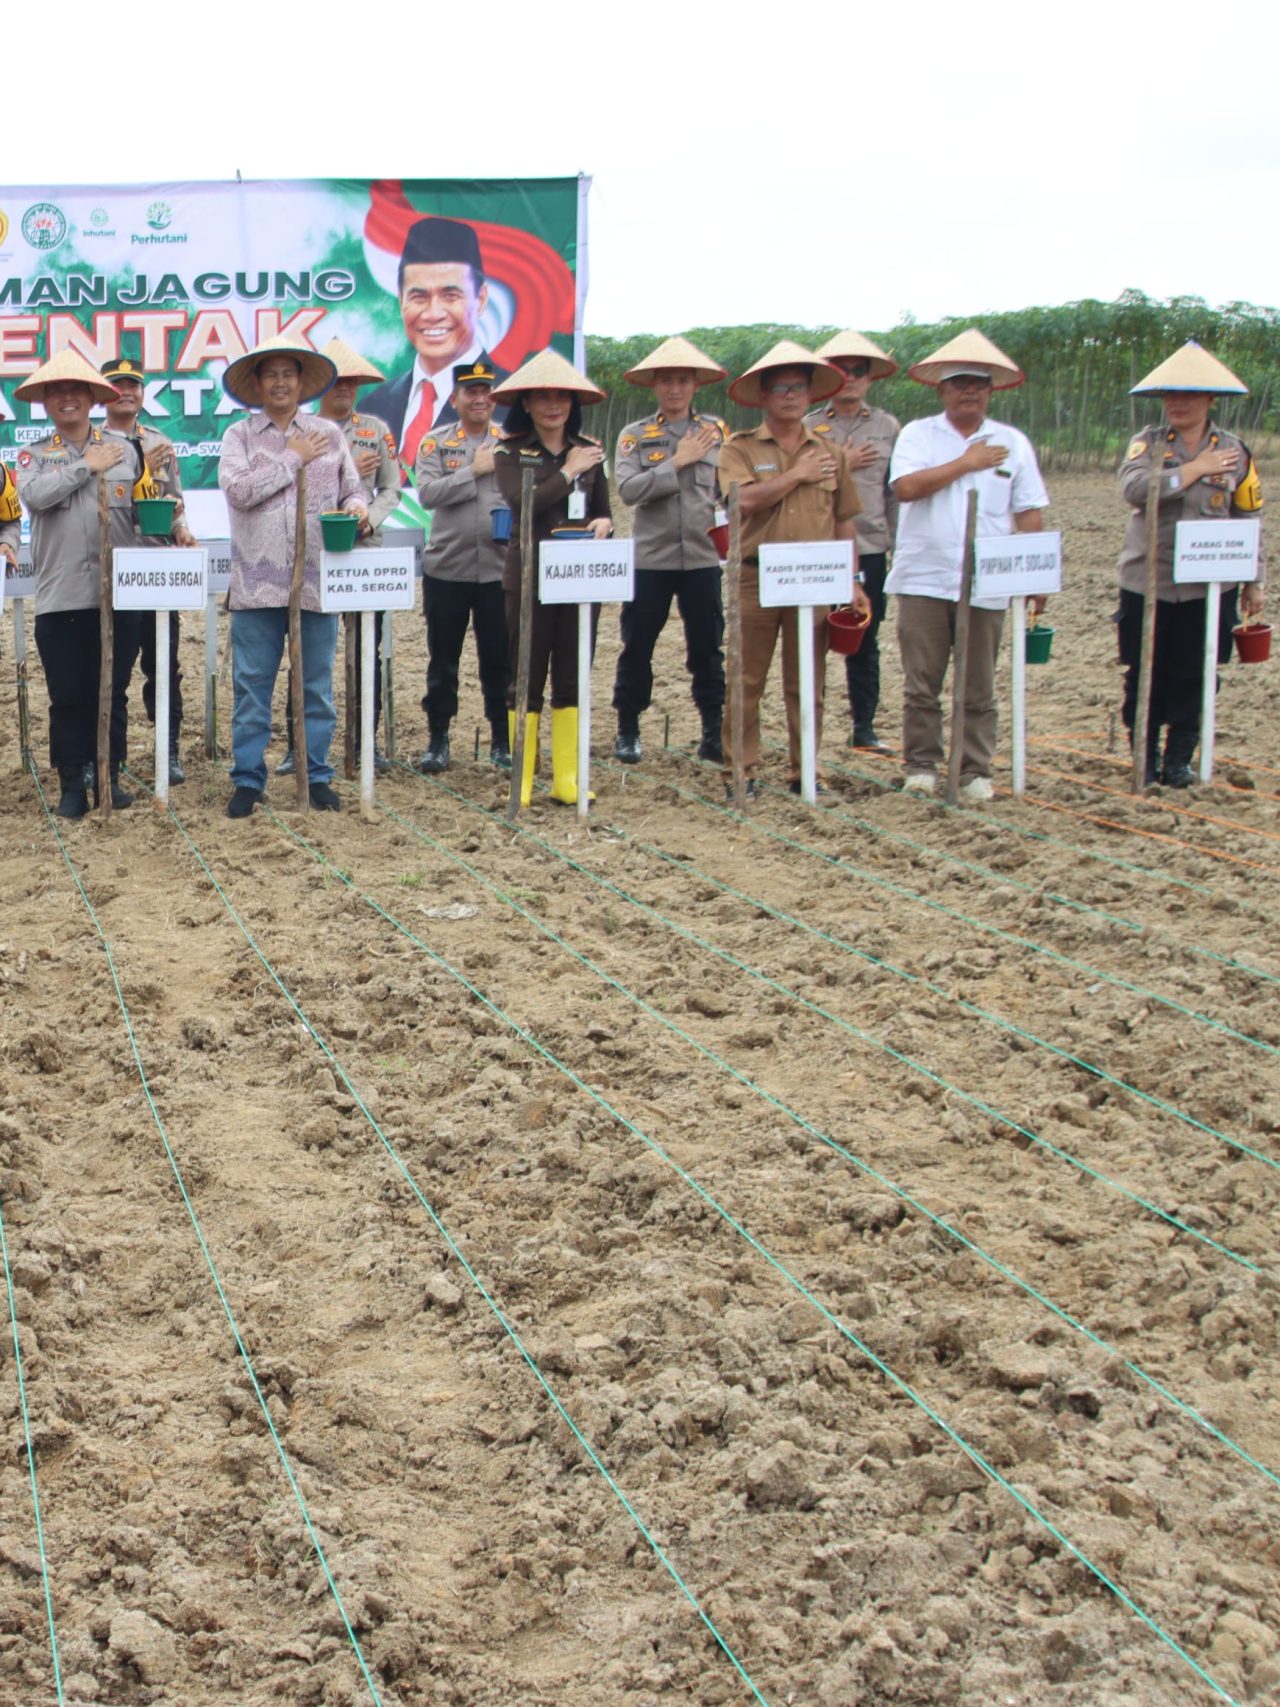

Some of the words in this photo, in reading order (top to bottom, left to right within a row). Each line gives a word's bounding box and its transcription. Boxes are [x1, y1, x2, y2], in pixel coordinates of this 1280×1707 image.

[131, 233, 187, 245] Perhutani
[120, 270, 355, 304] JAGUNG
[327, 568, 369, 578] KETUA
[373, 567, 407, 577] DPRD
[545, 564, 584, 580] KAJARI
[588, 563, 627, 579] SERGAI
[766, 565, 793, 574] KADIS
[795, 563, 847, 572] PERTANIAN
[118, 571, 166, 587] KAPOLRES
[169, 572, 202, 588] SERGAI
[802, 576, 834, 584] SERGAI
[327, 584, 357, 594] KAB.
[361, 582, 408, 592] SERGAI
